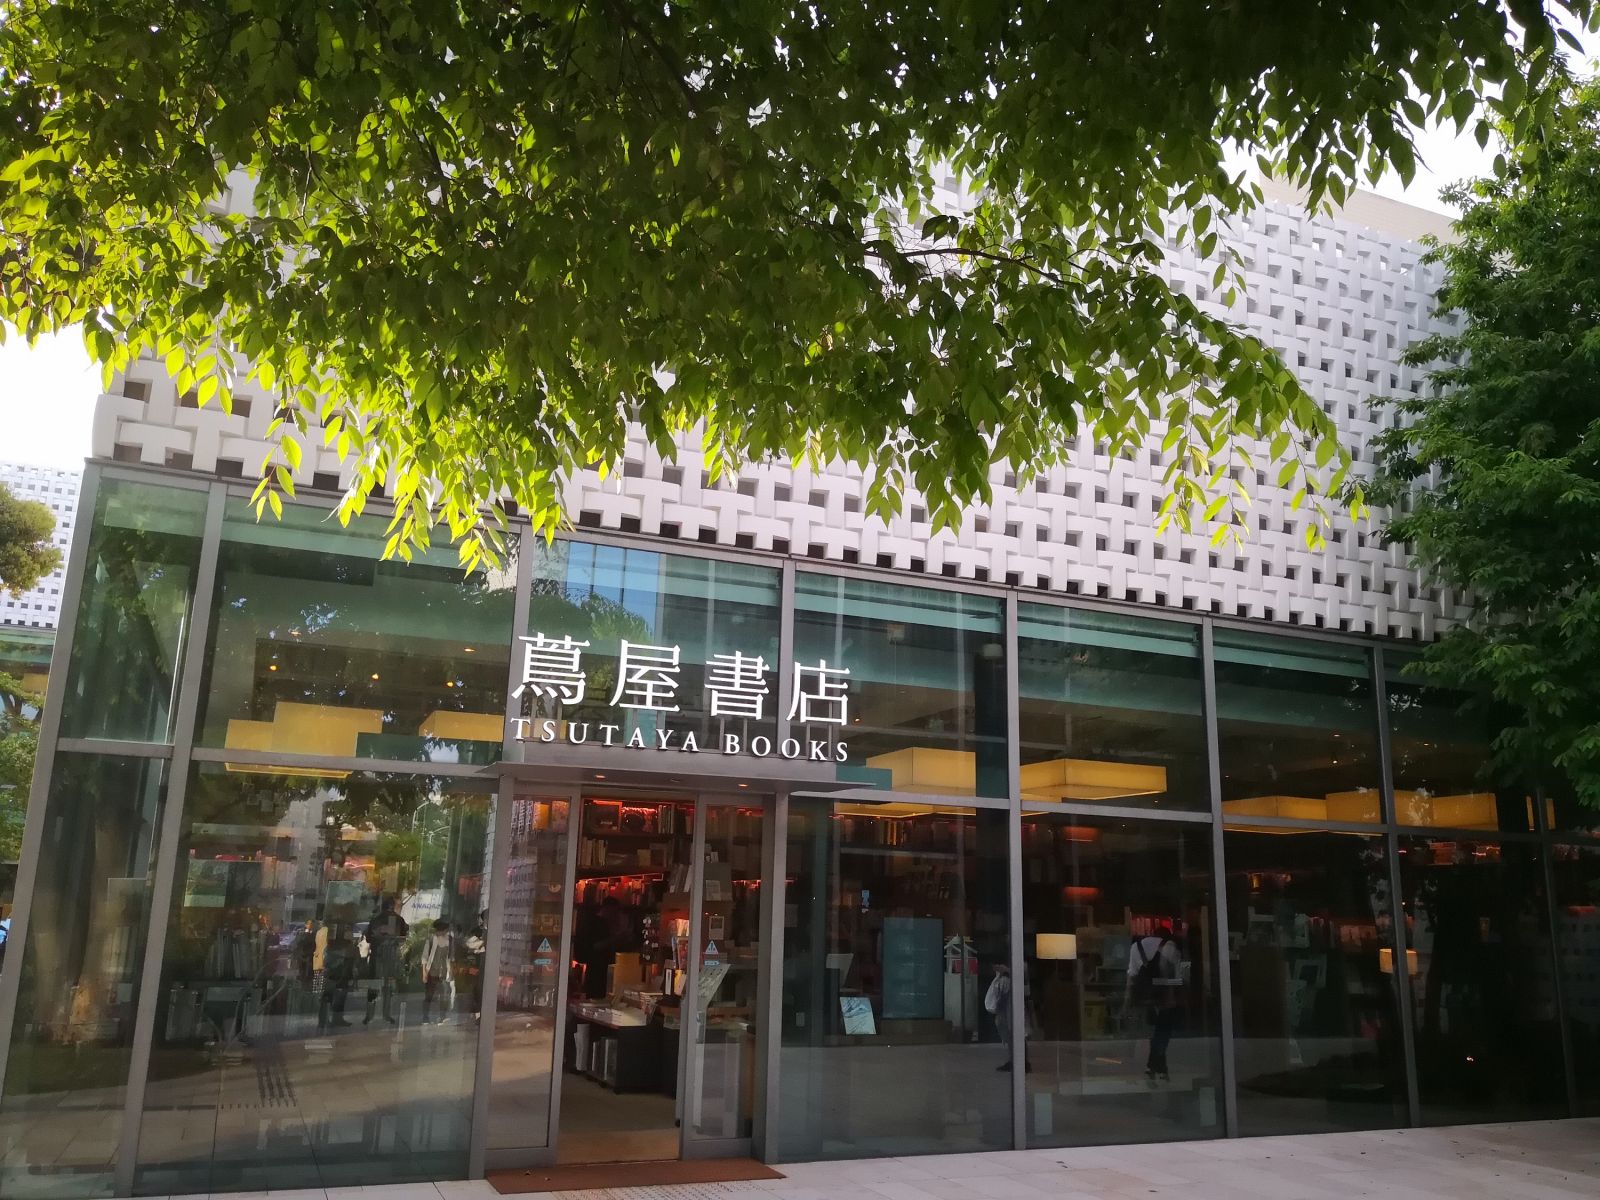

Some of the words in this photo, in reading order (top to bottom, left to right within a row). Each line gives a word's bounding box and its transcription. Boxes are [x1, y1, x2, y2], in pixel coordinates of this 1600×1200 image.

[511, 632, 850, 726] 蔦屋書店
[510, 717, 699, 752] TSUTAYA
[723, 734, 849, 762] BOOKS
